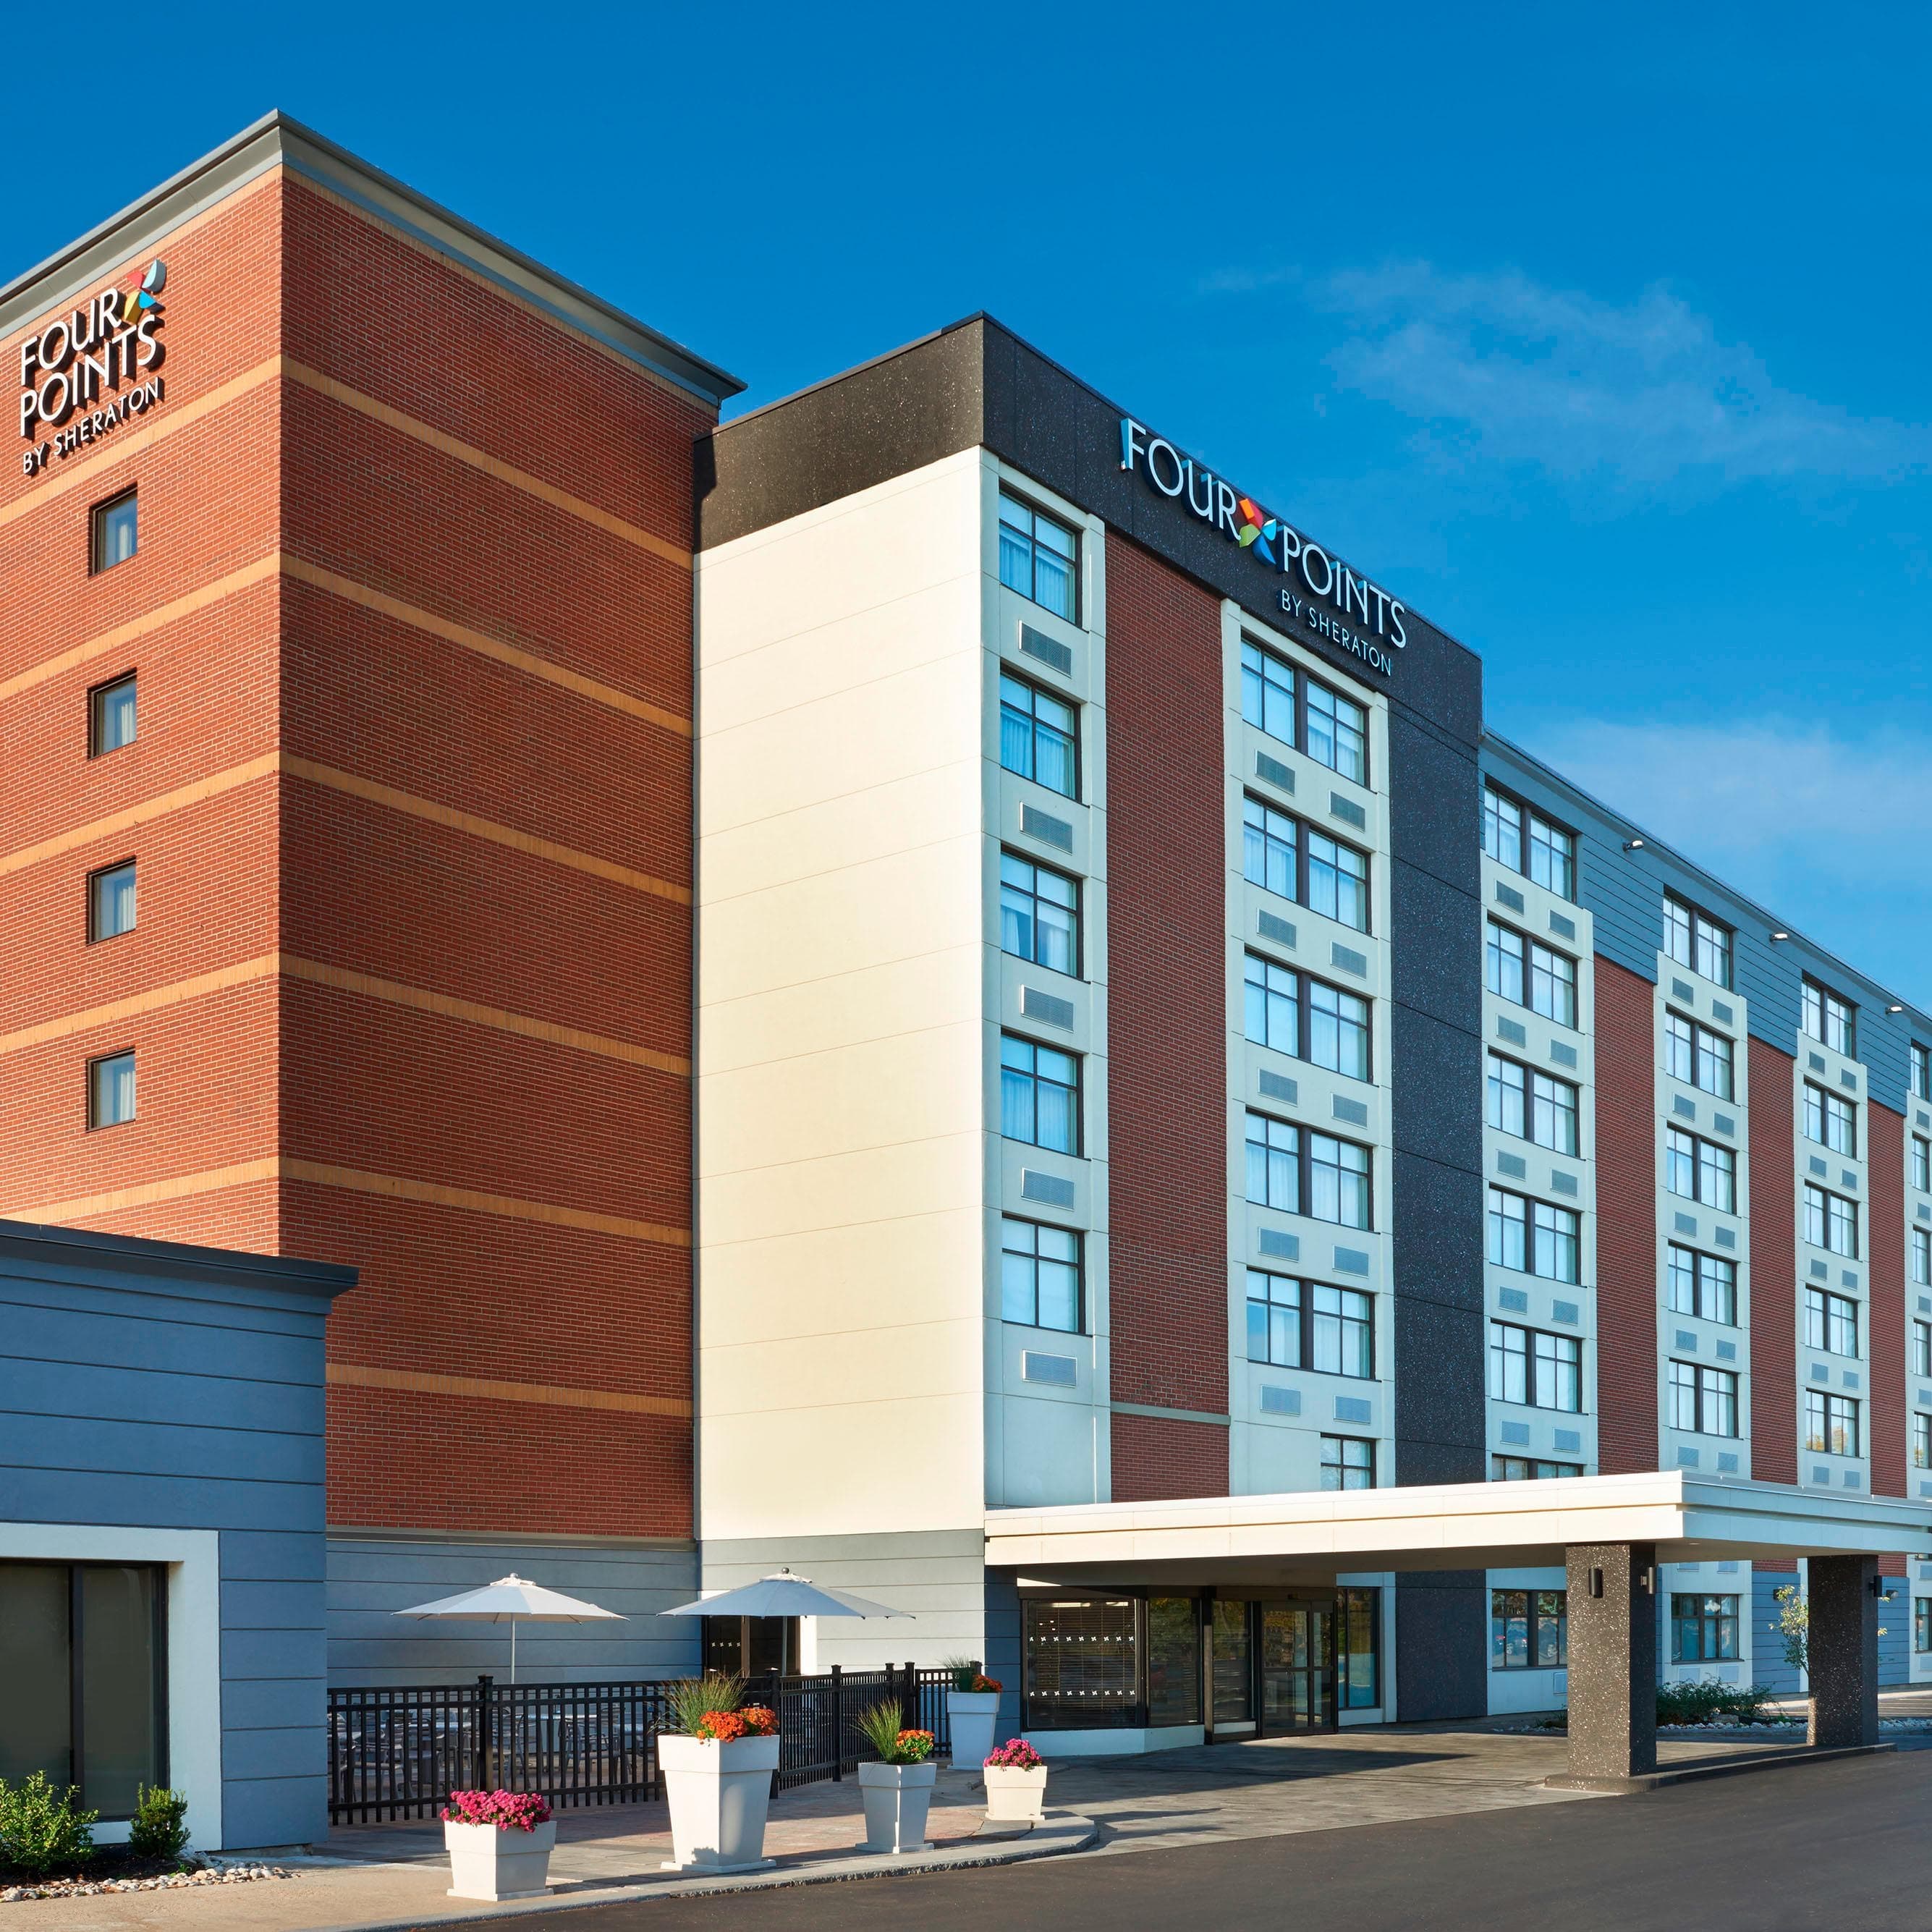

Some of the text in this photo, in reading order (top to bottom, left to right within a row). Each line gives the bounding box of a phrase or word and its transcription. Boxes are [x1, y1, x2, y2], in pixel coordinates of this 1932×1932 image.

[20, 314, 158, 437] POINTS
[21, 287, 122, 386] FOUR
[23, 376, 160, 475] BY SHERATON
[1122, 418, 1407, 649] FOUR POINTS
[1281, 589, 1391, 677] BY SHERATON
